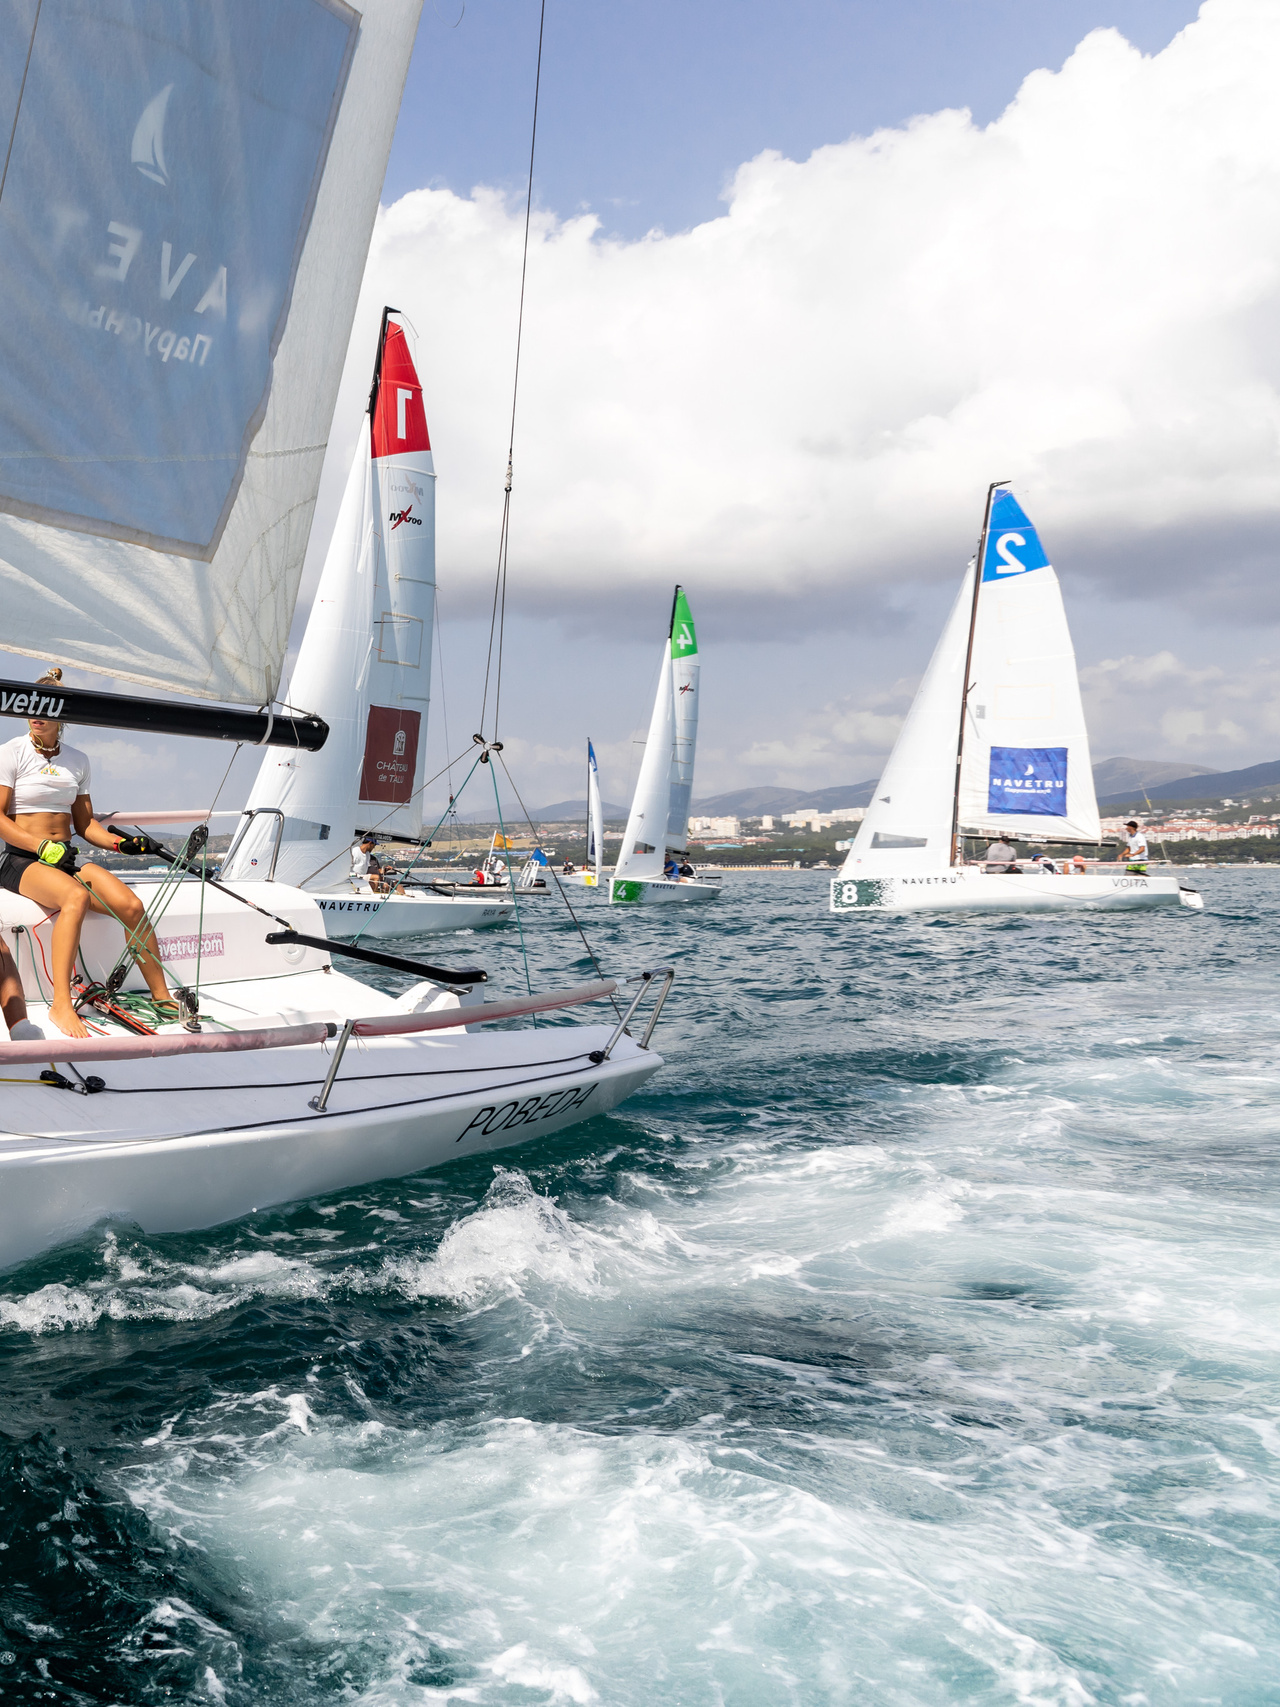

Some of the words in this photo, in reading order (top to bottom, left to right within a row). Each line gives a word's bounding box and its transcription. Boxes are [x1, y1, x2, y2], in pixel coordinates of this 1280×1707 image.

[389, 505, 423, 530] MX700
[378, 773, 387, 781] de
[992, 778, 1064, 788] NAVETRU
[902, 877, 957, 885] NAVETRU
[1112, 878, 1149, 888] VOITA
[617, 883, 627, 898] 4
[841, 883, 858, 904] 8
[319, 901, 380, 912] NAVETRU
[158, 938, 223, 957] avetru.com
[455, 1082, 600, 1143] POBEDA
